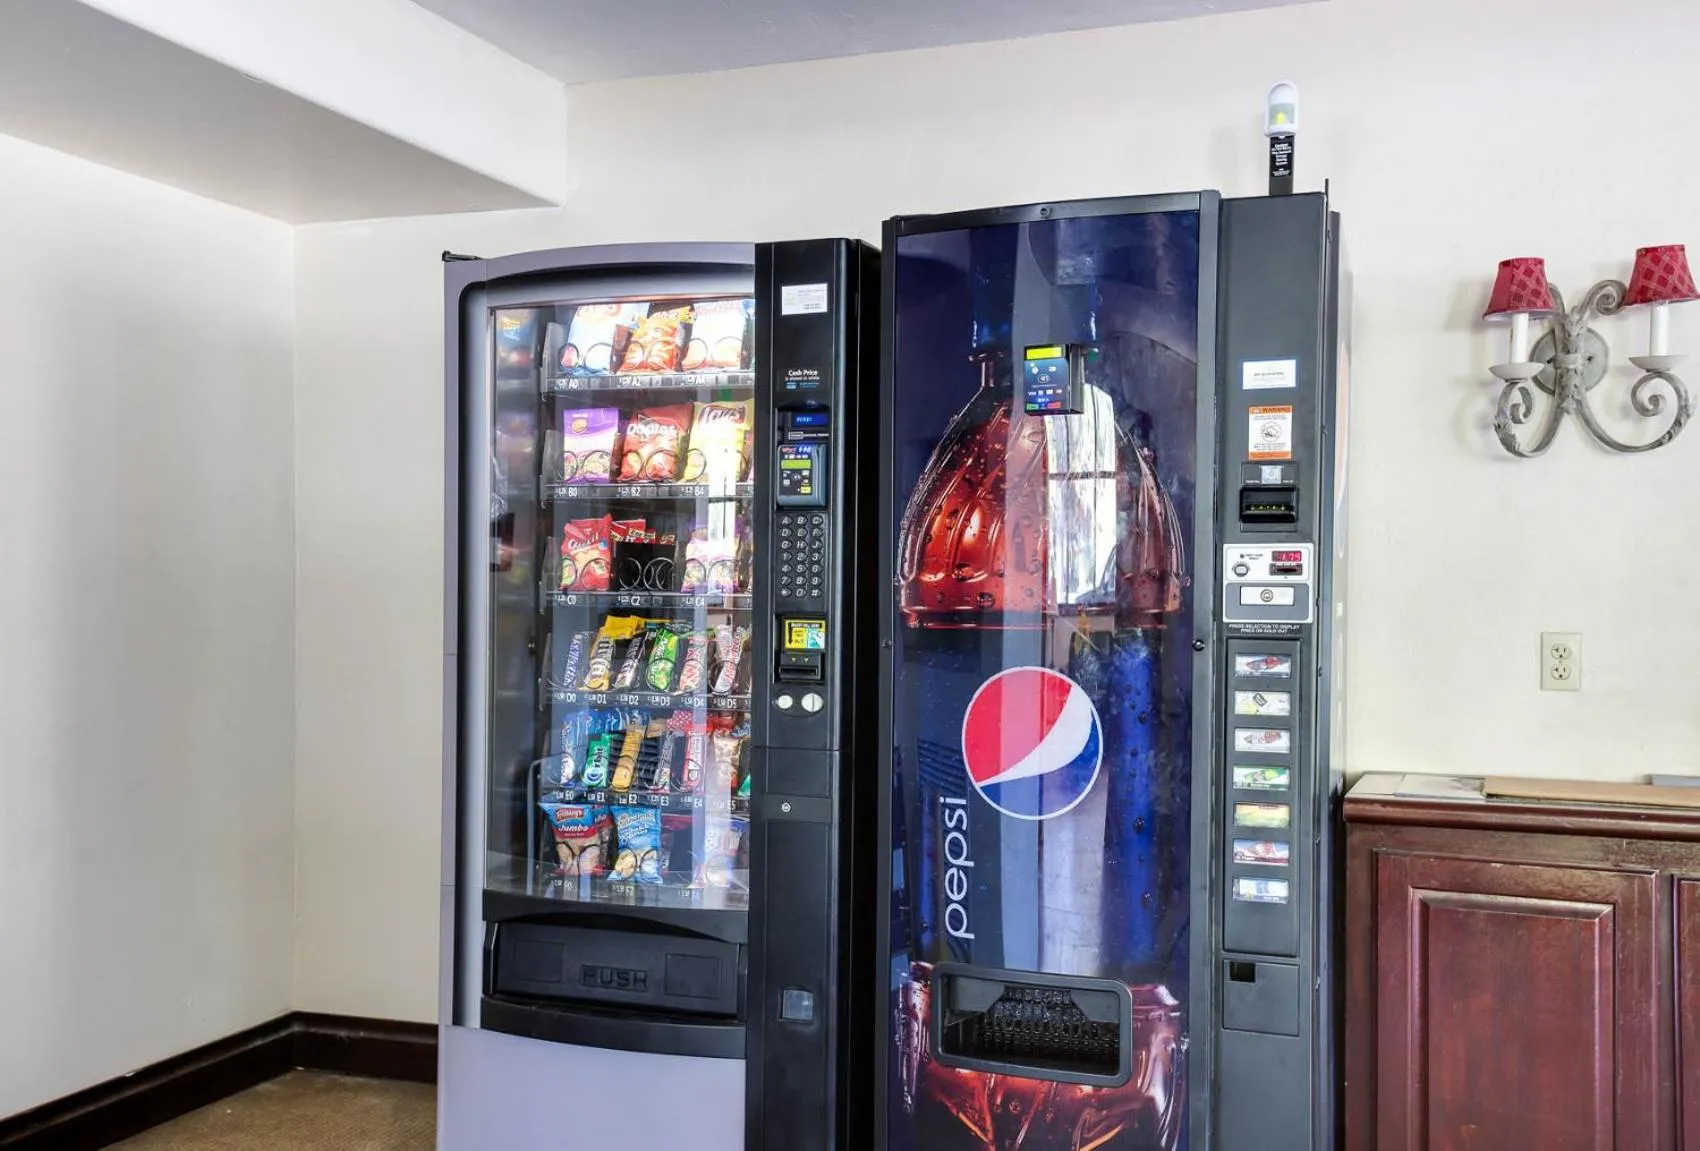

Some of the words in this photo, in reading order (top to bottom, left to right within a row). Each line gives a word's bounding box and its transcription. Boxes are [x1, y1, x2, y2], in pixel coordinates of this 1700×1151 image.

[630, 596, 640, 605] C2
[596, 694, 607, 704] D1
[628, 695, 639, 705] D2
[660, 696, 670, 706] D3
[727, 698, 737, 709] D5
[565, 790, 574, 800] E0
[596, 792, 605, 802] E1
[628, 794, 638, 804] E2
[660, 796, 670, 806] E3
[694, 798, 703, 808] E4
[558, 824, 588, 832] Jumbo
[939, 796, 975, 940] pepsi
[583, 969, 647, 988] PUSH
